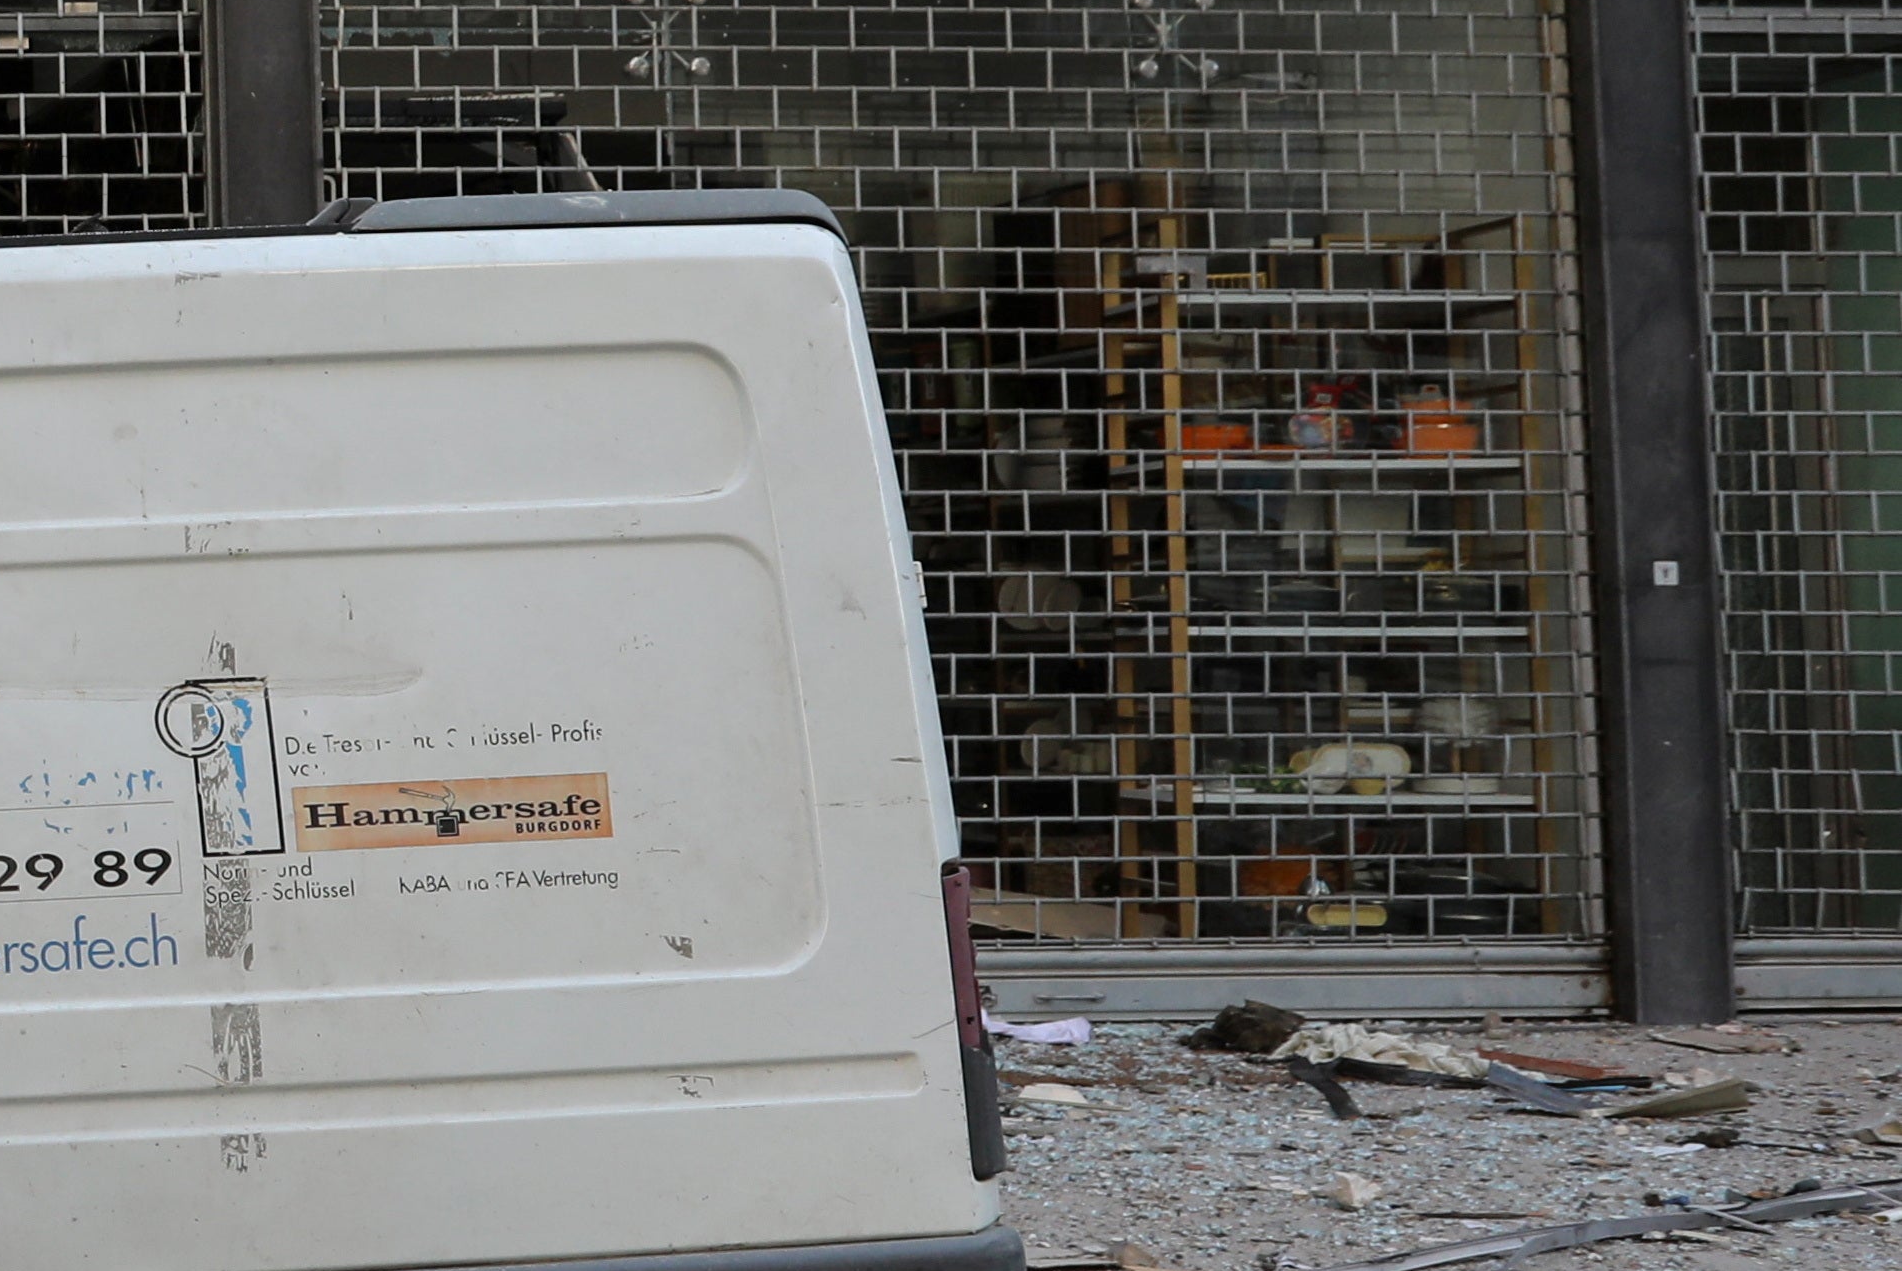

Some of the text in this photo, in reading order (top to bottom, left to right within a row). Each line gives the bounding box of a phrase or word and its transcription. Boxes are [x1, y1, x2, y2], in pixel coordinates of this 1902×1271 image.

[285, 736, 317, 755] De
[303, 794, 602, 830] Hammersafe
[514, 818, 603, 835] BURGDORF
[92, 847, 173, 888] 89
[532, 869, 619, 890] Vertretung
